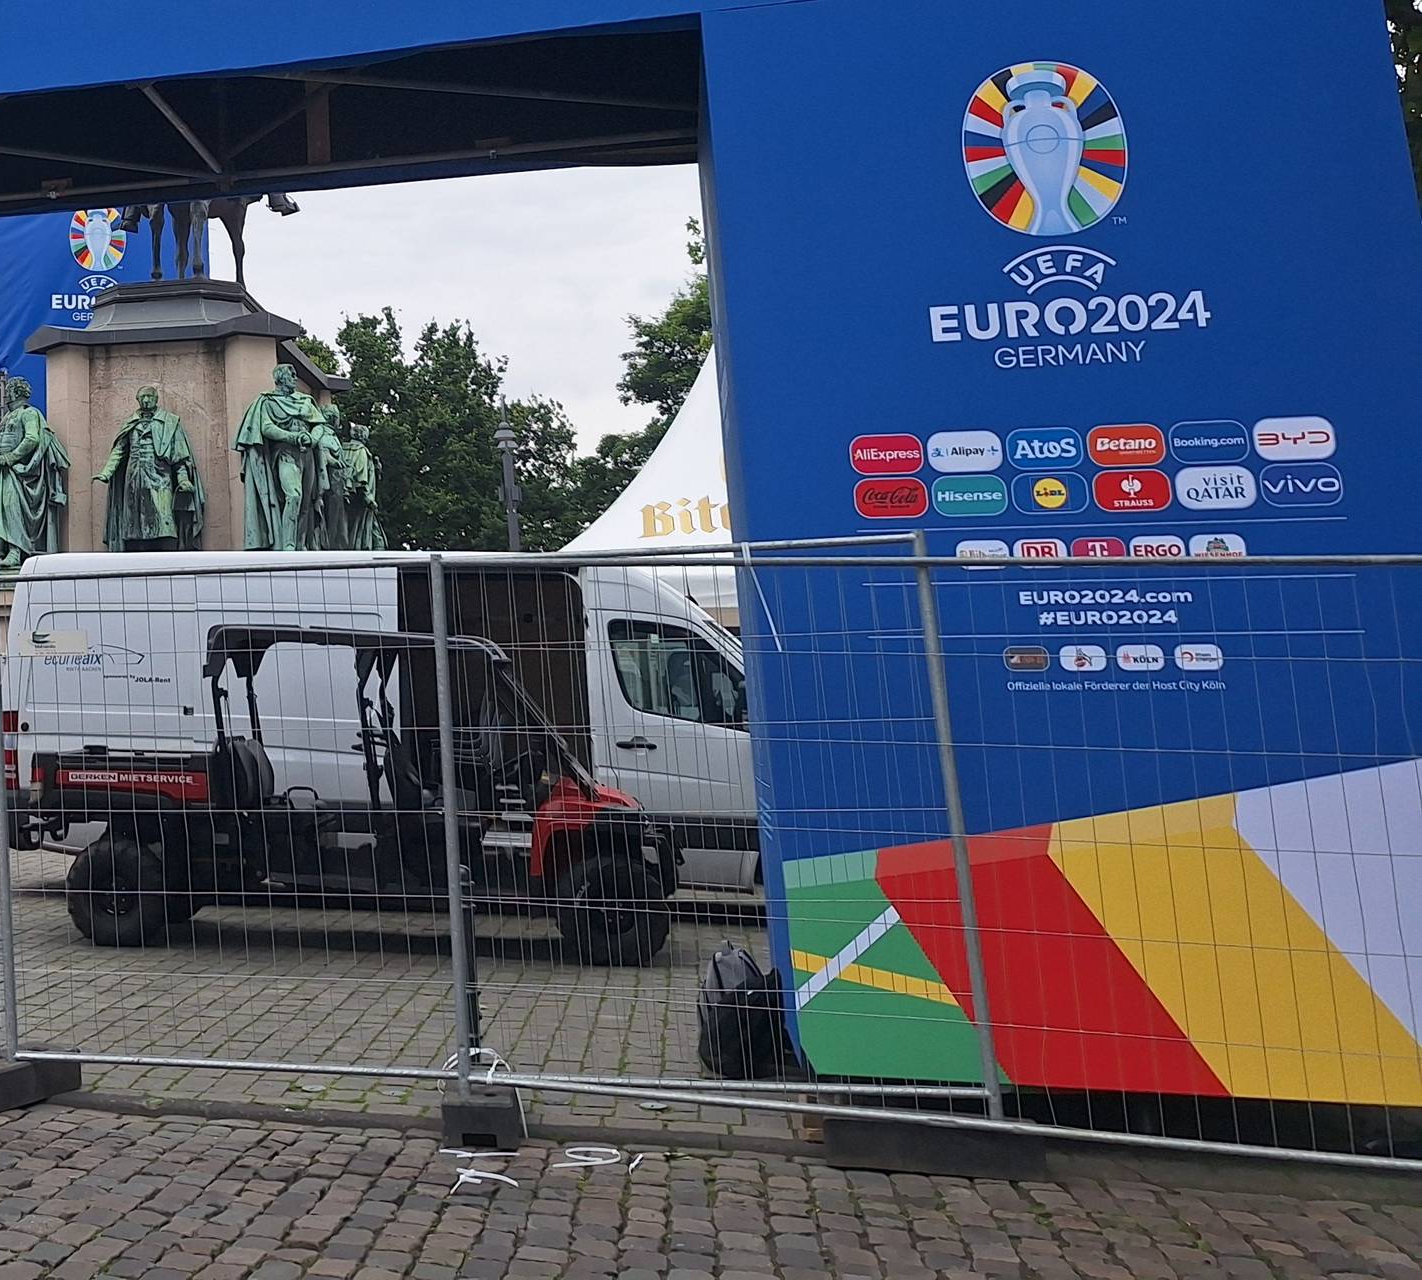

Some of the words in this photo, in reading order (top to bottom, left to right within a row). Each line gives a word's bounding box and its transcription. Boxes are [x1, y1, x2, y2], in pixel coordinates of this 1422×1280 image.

[1010, 253, 1105, 287] UEFA
[928, 289, 1211, 342] EURO2024
[994, 340, 1146, 369] GERMANY
[1096, 437, 1157, 451] Betano
[1173, 436, 1245, 448] Booking.com
[1257, 430, 1330, 446] BYD
[854, 448, 920, 462] AliExpress
[1202, 473, 1244, 486] visit
[1263, 475, 1340, 494] vivo
[937, 491, 1003, 502] Hisense
[1187, 487, 1247, 503] QATAR
[1113, 499, 1154, 508] STRAUSS
[1133, 543, 1182, 557] ERGO
[1018, 589, 1193, 606] EURO2024.com
[1038, 609, 1179, 626] #EURO2024
[1132, 681, 1149, 690] der
[1152, 680, 1178, 690] Host
[1178, 680, 1200, 693] City
[1201, 680, 1226, 690] Köln
[119, 774, 194, 784] MIETSERVICE
